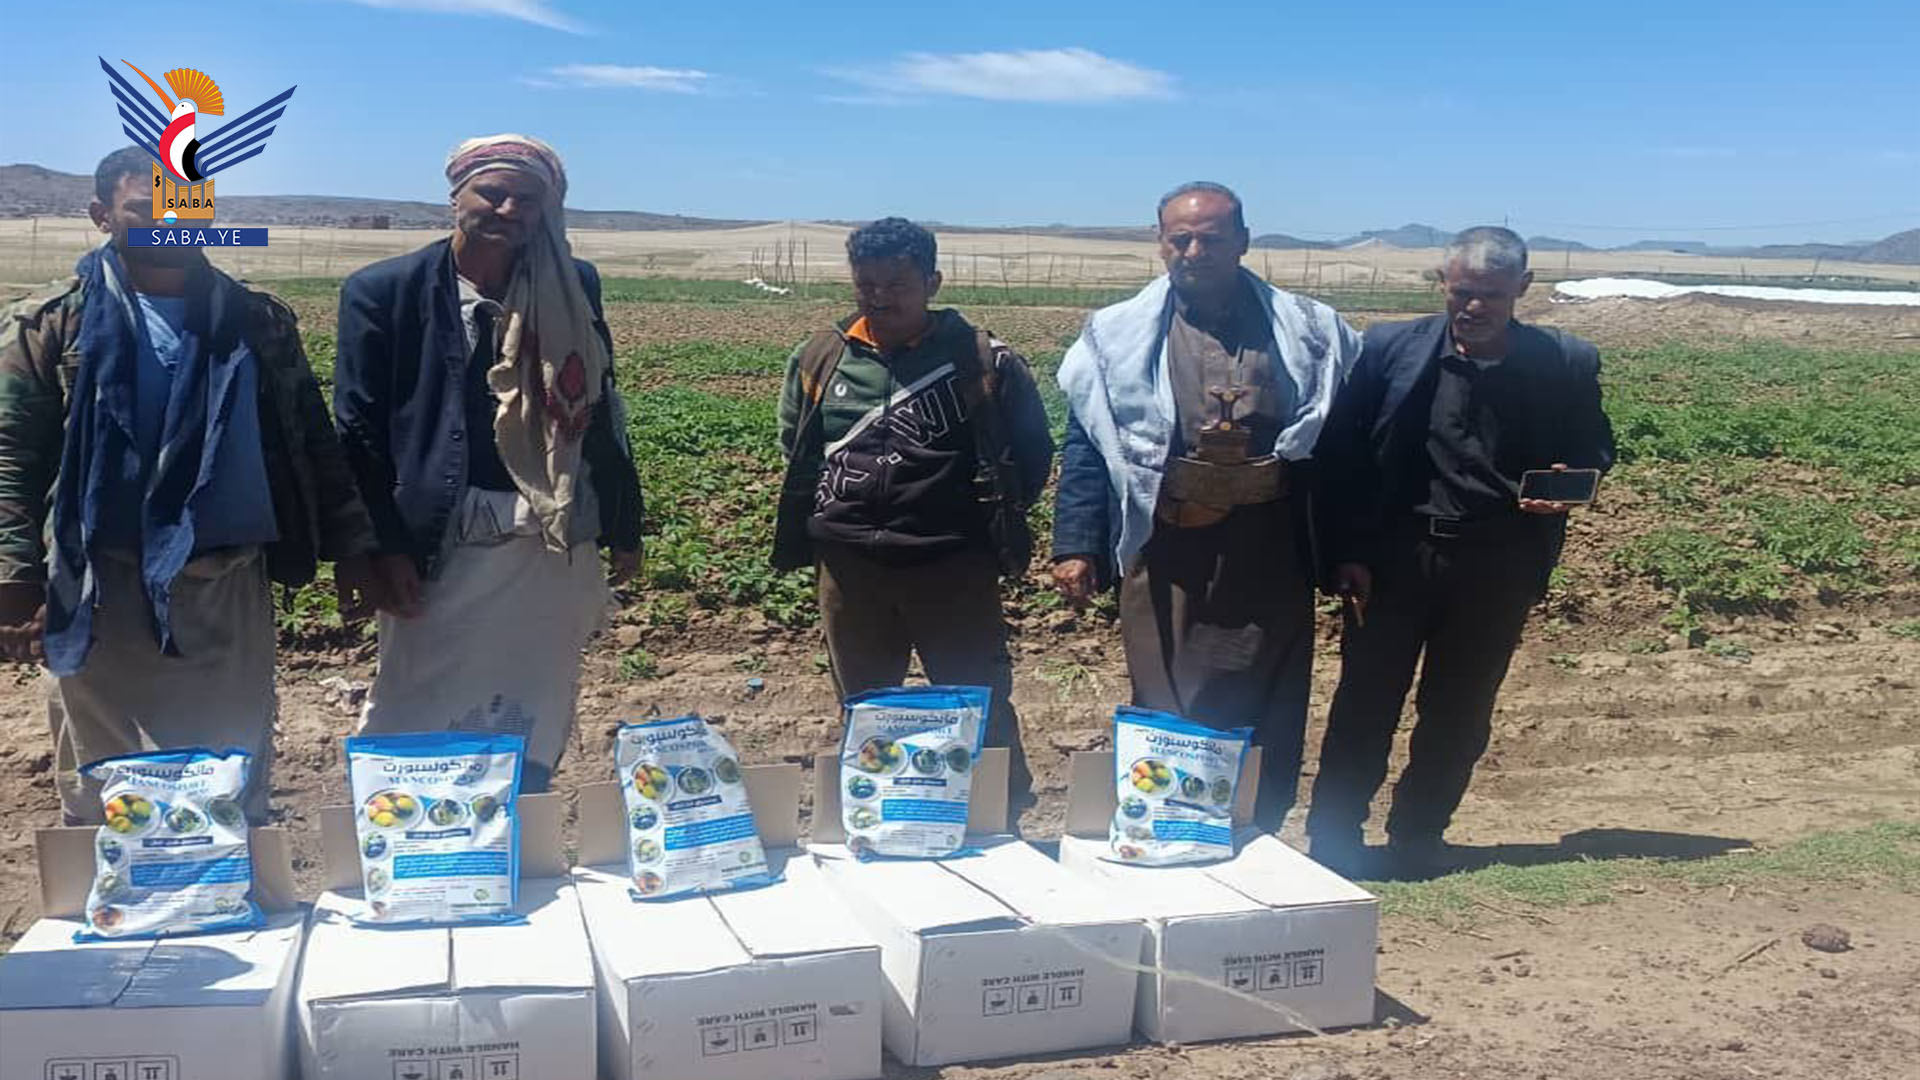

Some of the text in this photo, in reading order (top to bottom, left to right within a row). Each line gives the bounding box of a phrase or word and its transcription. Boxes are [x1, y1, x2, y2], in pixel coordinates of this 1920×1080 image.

[383, 761, 484, 774] مكوسبورت
[734, 1010, 766, 1020] WITH
[387, 1041, 519, 1057] HANDLE WITH CARE
